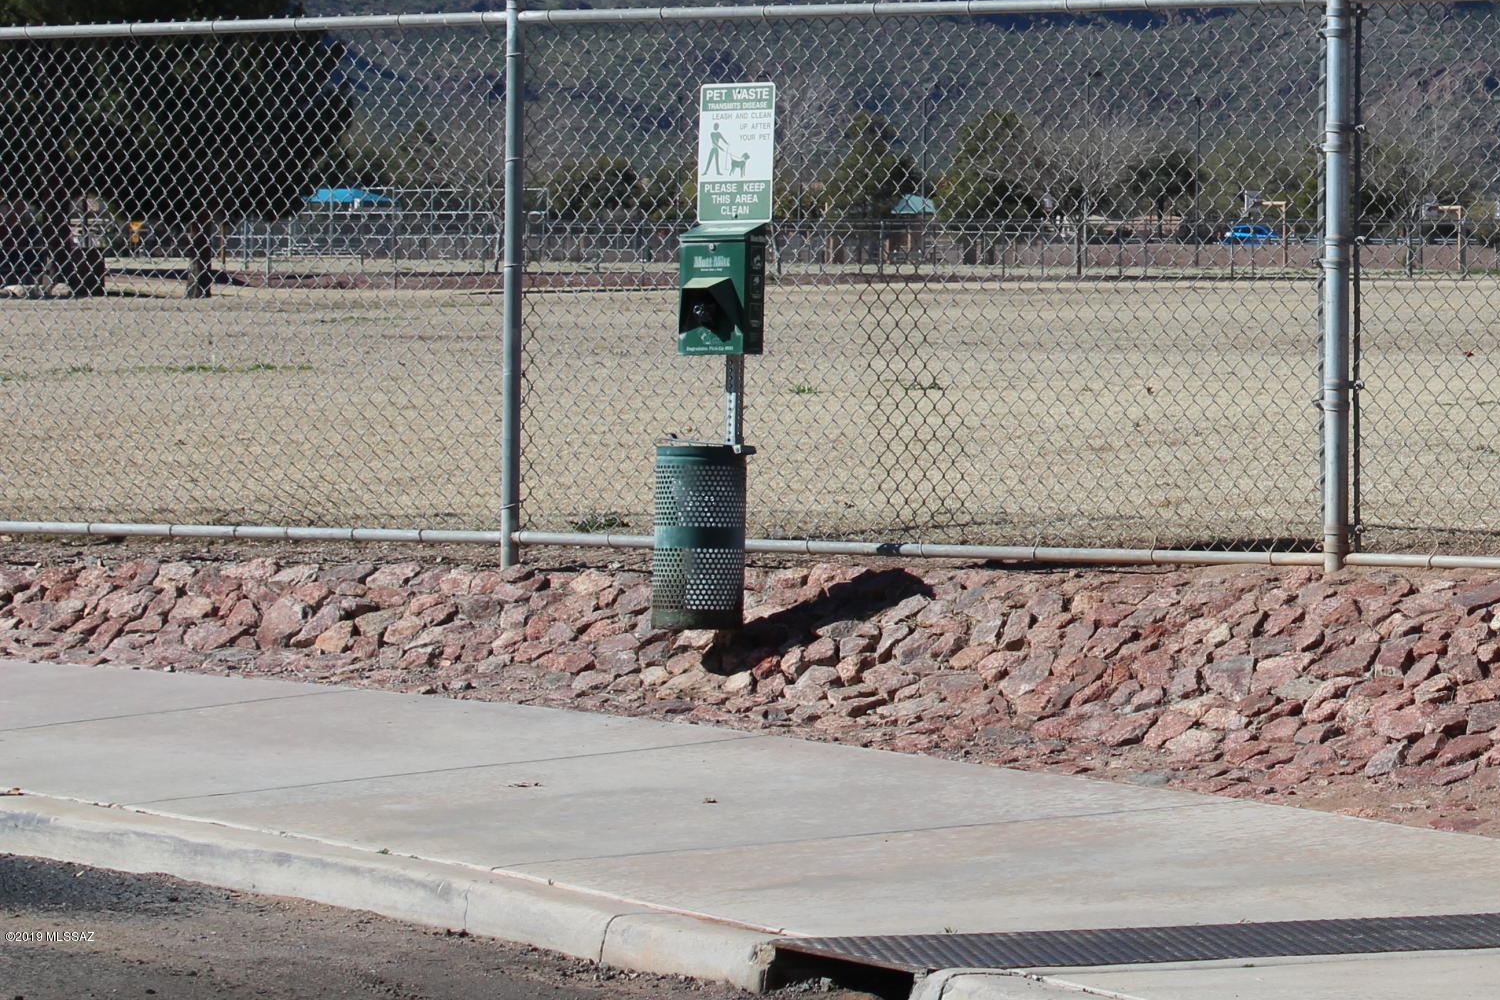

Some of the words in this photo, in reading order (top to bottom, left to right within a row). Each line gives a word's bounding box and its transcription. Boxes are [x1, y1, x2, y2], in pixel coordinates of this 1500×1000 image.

[706, 89, 728, 101] PET
[732, 88, 770, 100] WASTE
[708, 102, 741, 110] TRANSMITS
[742, 101, 768, 109] DISEASE
[712, 112, 733, 120] LEASH
[735, 112, 749, 120] AND
[751, 111, 772, 119] CLEAN
[751, 122, 771, 130] AFTER
[739, 133, 756, 141] YOUR
[758, 132, 771, 140] PET
[704, 183, 738, 193] PLEASE
[743, 182, 766, 192] KEEP
[711, 195, 731, 204] THIS
[735, 194, 758, 203] AREA
[720, 205, 750, 215] CLEAN
